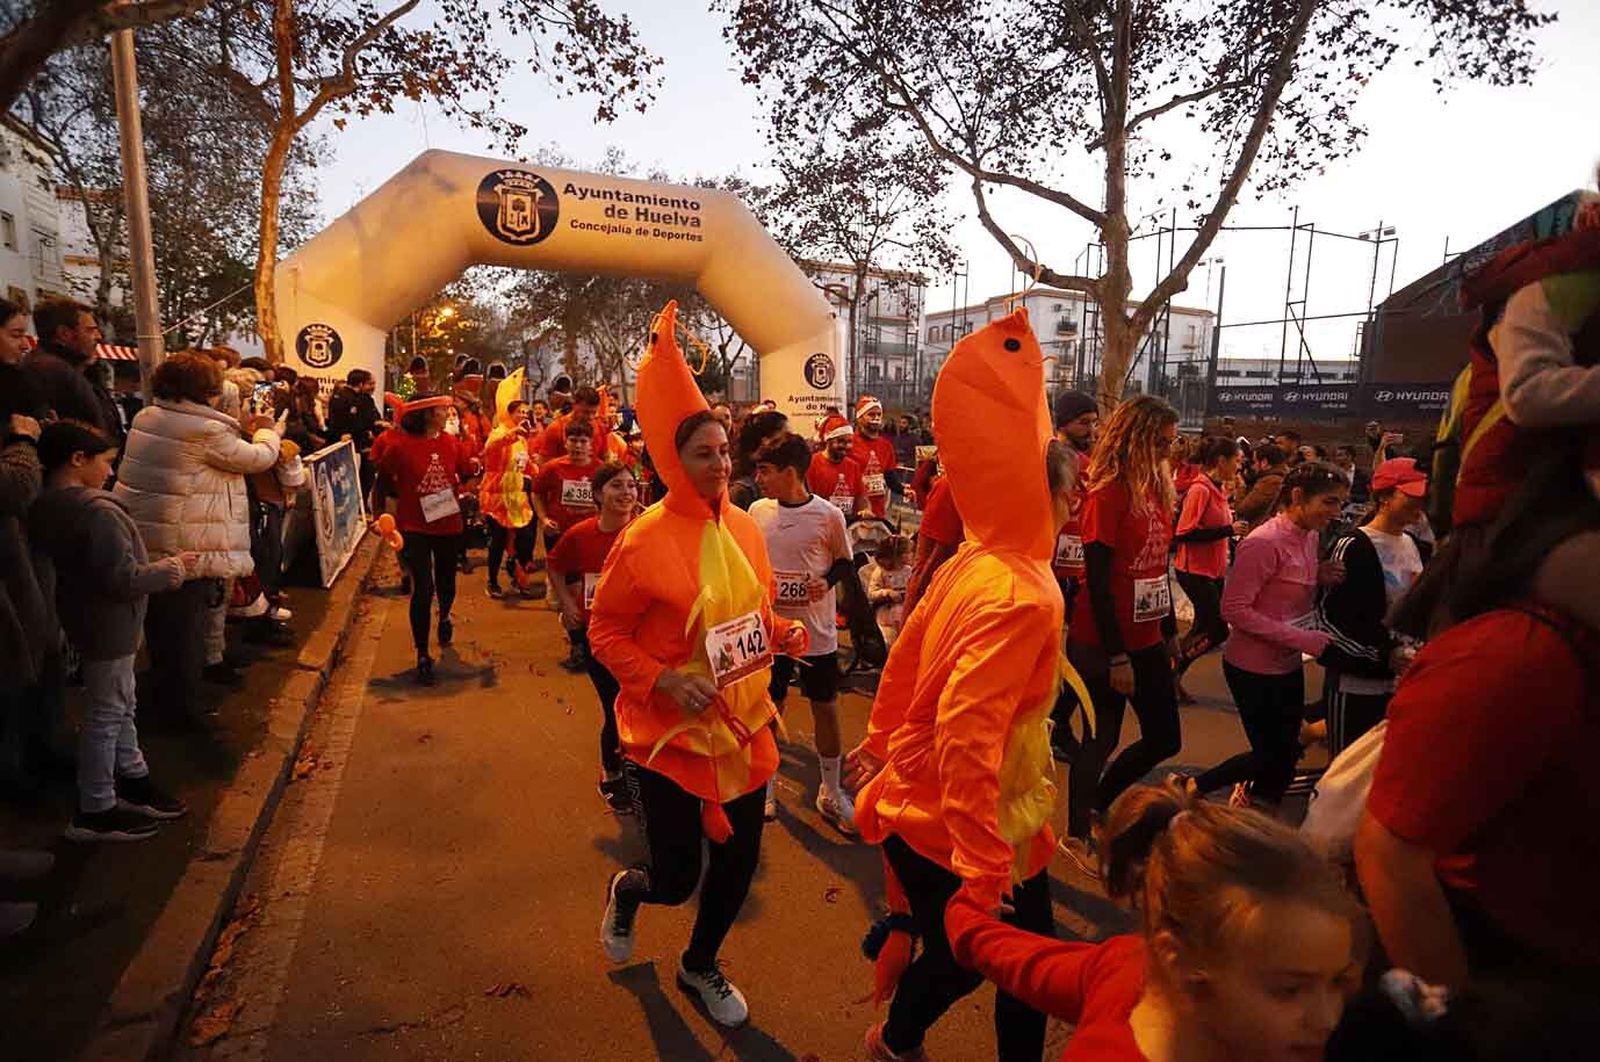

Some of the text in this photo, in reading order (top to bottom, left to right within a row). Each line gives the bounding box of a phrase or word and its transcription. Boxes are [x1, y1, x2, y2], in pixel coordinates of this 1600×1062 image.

[563, 183, 701, 211] Ayuntamiento
[604, 204, 701, 228] de Huelva
[635, 227, 649, 237] de
[653, 228, 703, 242] Deportes
[1234, 392, 1273, 401] HYUNDAI
[1302, 391, 1346, 401] HYUNDAI
[1395, 391, 1449, 400] HYUNDA
[780, 581, 807, 598] 268
[736, 629, 766, 660] 142
